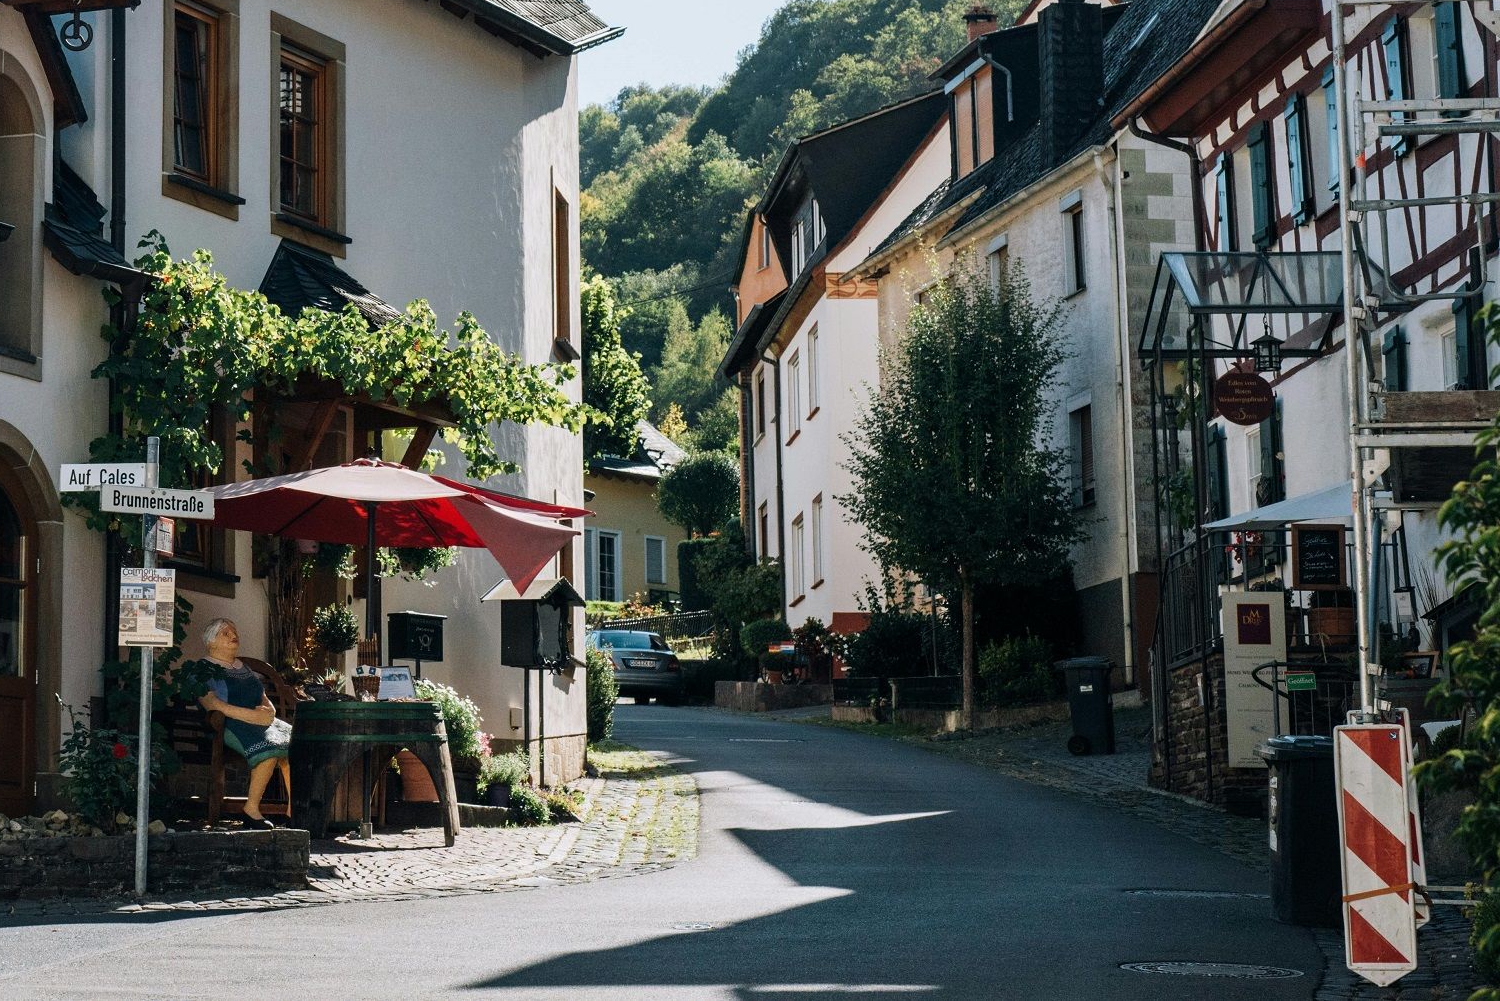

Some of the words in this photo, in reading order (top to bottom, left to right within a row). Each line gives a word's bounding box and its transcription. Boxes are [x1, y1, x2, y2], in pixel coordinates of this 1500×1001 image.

[69, 469, 92, 485] Auf
[99, 468, 135, 485] Cales
[113, 490, 204, 513] Brunnenstraße
